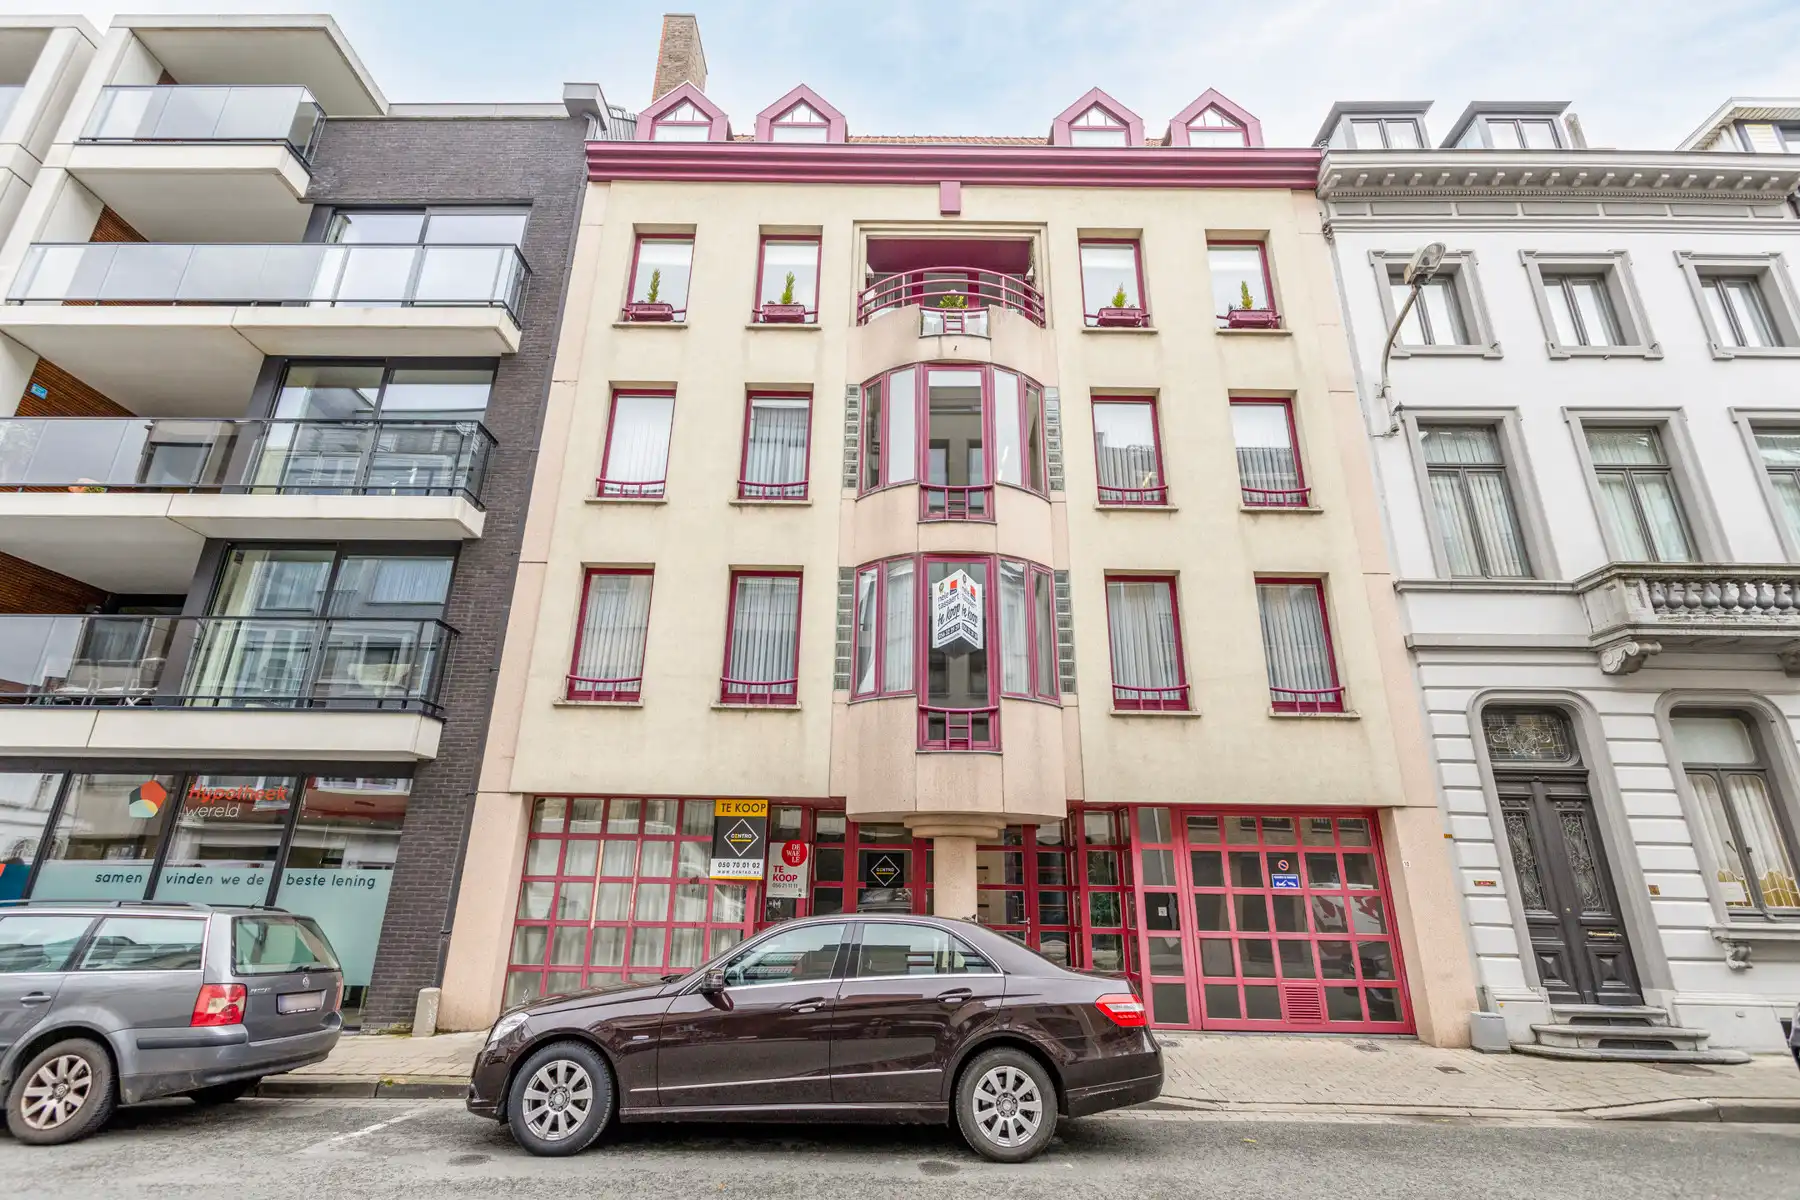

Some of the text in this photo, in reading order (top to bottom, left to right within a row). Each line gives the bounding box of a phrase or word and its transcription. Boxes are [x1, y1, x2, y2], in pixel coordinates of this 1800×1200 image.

[188, 783, 289, 804] Hypotheek
[185, 803, 241, 818] wereld
[721, 803, 767, 813] TE KOOP
[773, 865, 784, 873] TE
[95, 872, 376, 890] samen vinden we de beste lening
[772, 874, 798, 882] KOOP
